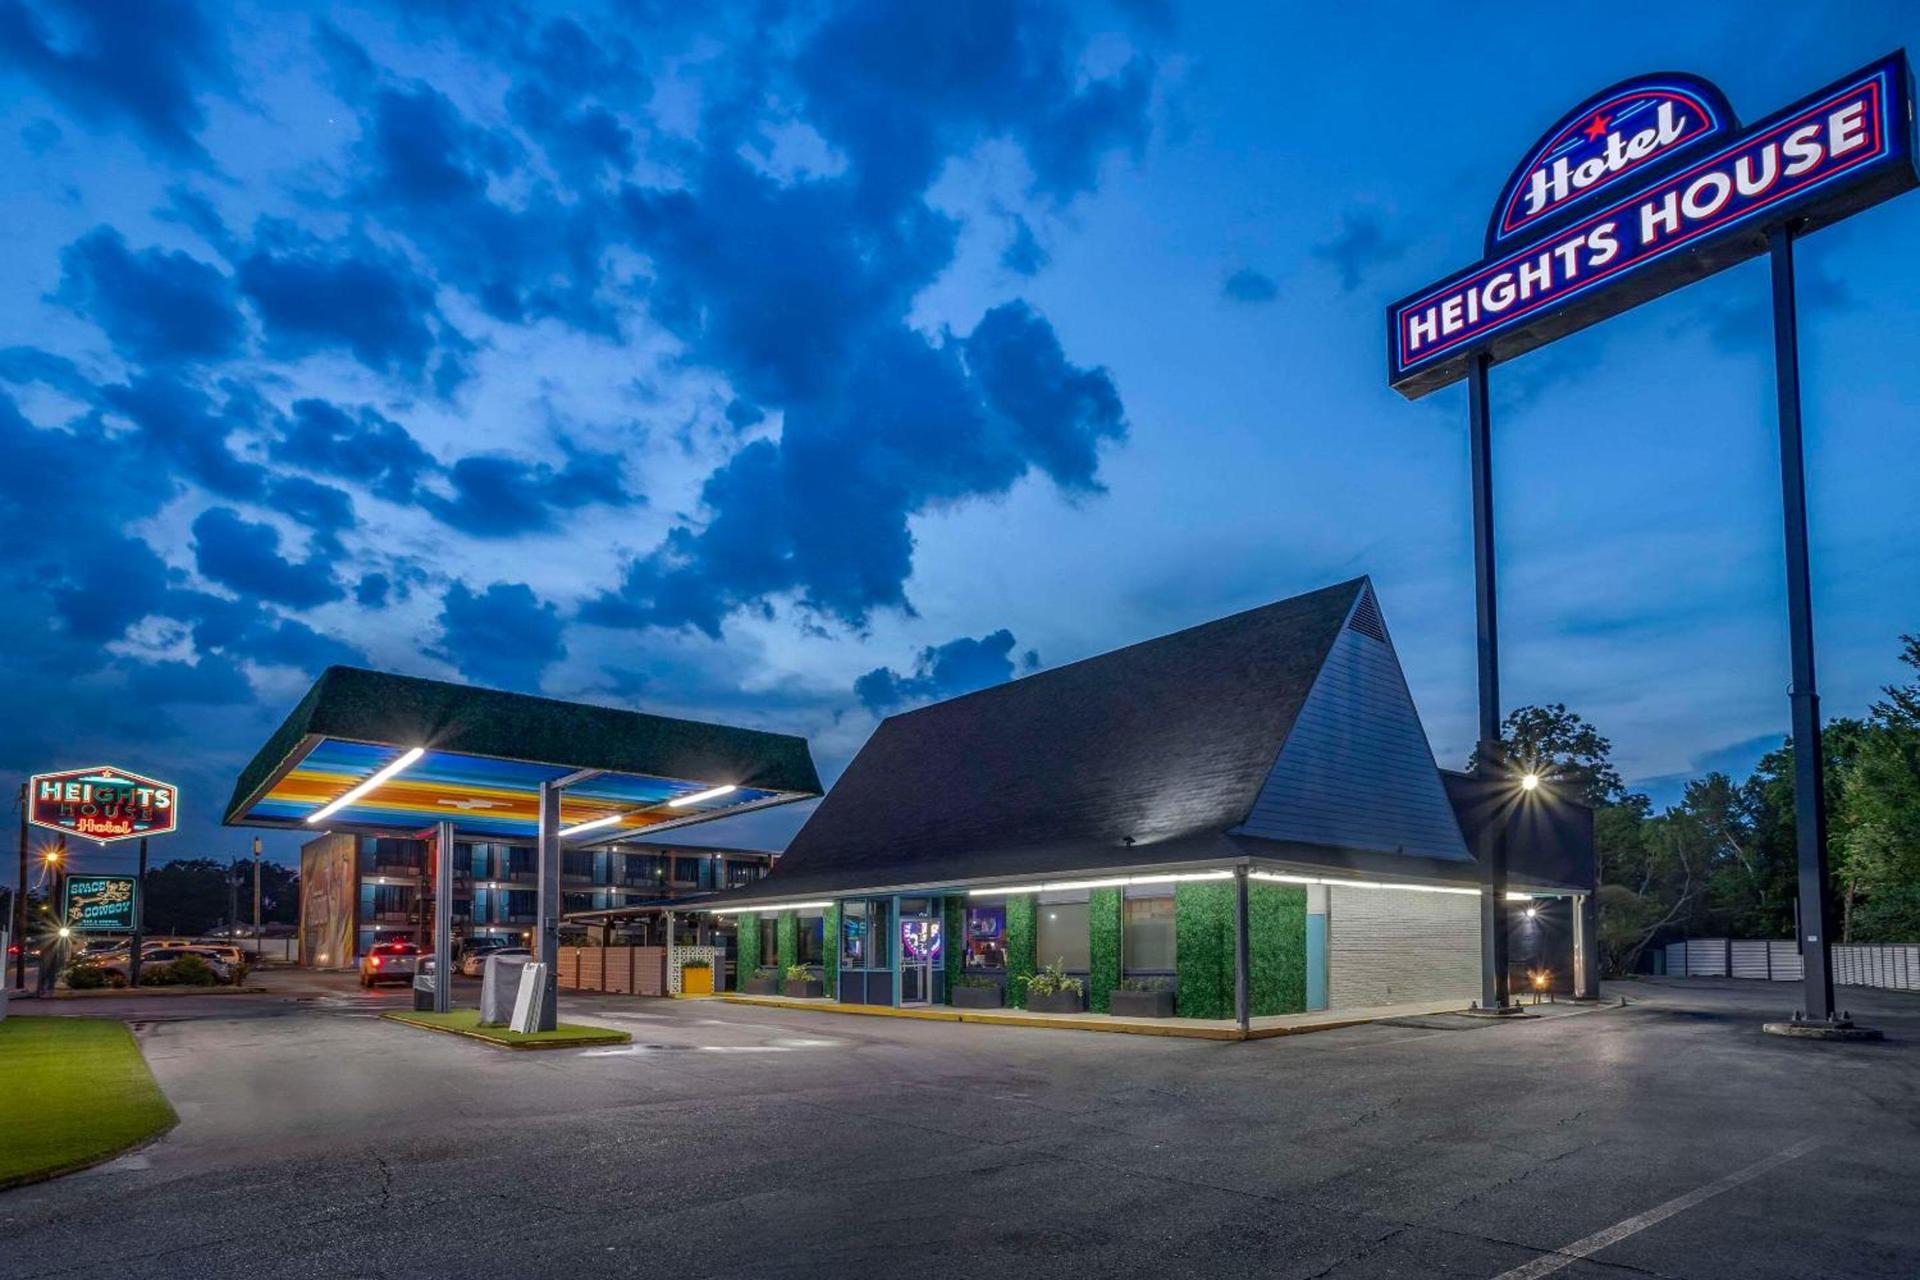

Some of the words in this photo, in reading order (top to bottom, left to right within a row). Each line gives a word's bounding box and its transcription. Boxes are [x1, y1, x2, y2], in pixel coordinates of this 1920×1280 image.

[1524, 101, 1686, 215] Hotel
[1408, 221, 1620, 350] HEIGHTS
[1640, 100, 1868, 244] HOUSE
[40, 781, 171, 808] HEIGHTS
[60, 803, 153, 821] HOUSE
[77, 818, 131, 834] Hotel
[71, 881, 106, 894] SPACE
